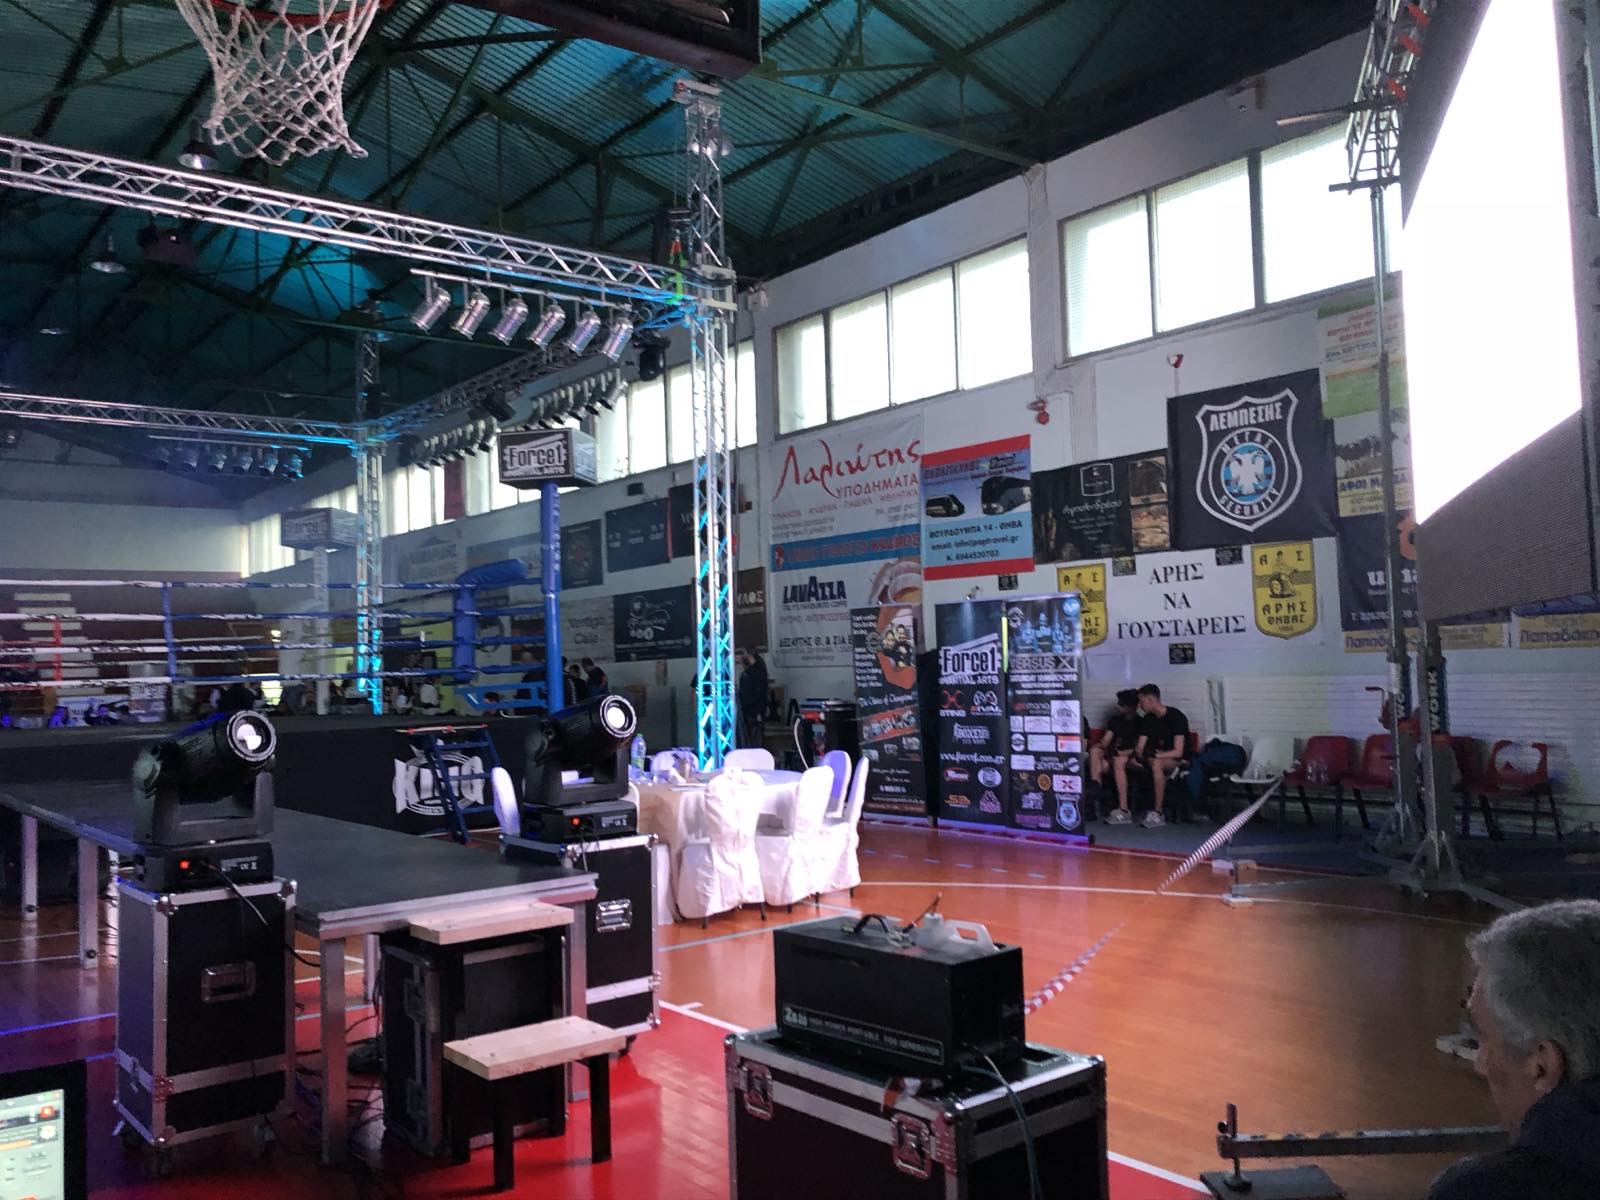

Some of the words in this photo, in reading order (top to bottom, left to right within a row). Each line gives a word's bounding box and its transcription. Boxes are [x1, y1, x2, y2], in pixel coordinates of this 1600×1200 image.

[1210, 402, 1283, 431] ΛΕΜΠΕΣΗΣ
[508, 444, 563, 469] Force1
[543, 465, 566, 475] ARTS
[837, 473, 919, 499] ΥΠΟΔΗΜΑΤΑ
[1219, 487, 1281, 516] SECURITY
[984, 523, 993, 531] 14
[999, 520, 1023, 530] ΘΗΒΑ
[1149, 562, 1204, 585] ΑΡΗΣ
[783, 576, 847, 604] LAVAZZA
[1163, 591, 1192, 610] ΝΑ
[1262, 601, 1308, 615] ΑΡΗΣ
[1267, 614, 1305, 625] ΘΗΒΑΣ
[1084, 616, 1100, 627] ΗΣ
[1117, 615, 1246, 639] ΓΟΥΣΤΑΡΕΙΣ
[943, 647, 996, 673] Force1
[1010, 656, 1056, 670] VERSUS
[977, 675, 999, 685] ARTS
[1427, 671, 1441, 731] WORK
